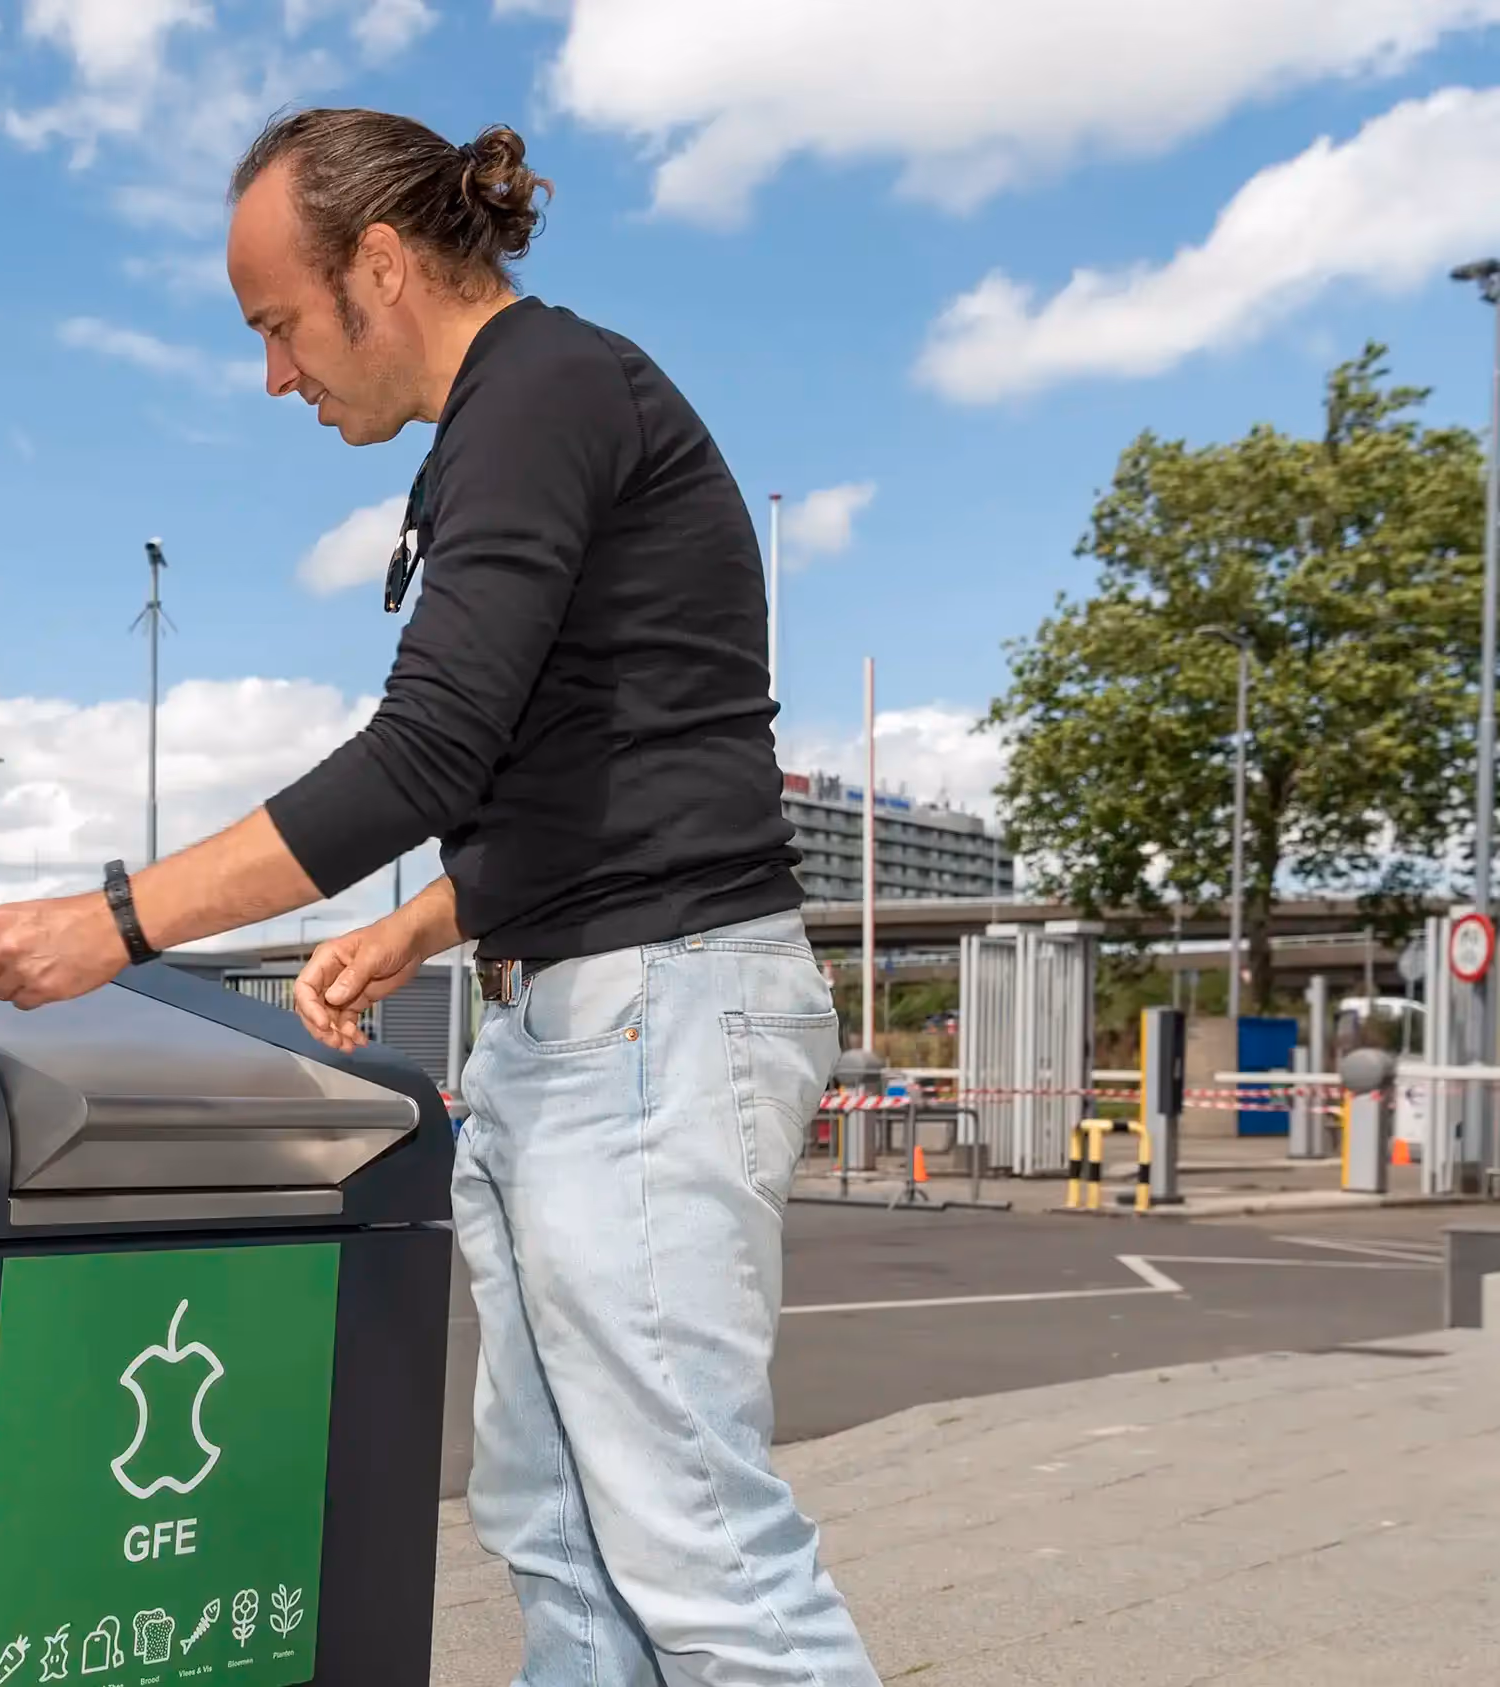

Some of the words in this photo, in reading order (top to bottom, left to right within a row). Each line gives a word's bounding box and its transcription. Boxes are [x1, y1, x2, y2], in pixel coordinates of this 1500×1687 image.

[123, 1517, 198, 1563] GFE
[272, 1650, 295, 1660] Planten
[227, 1658, 254, 1668] Bloemen
[140, 1675, 160, 1686] Brood
